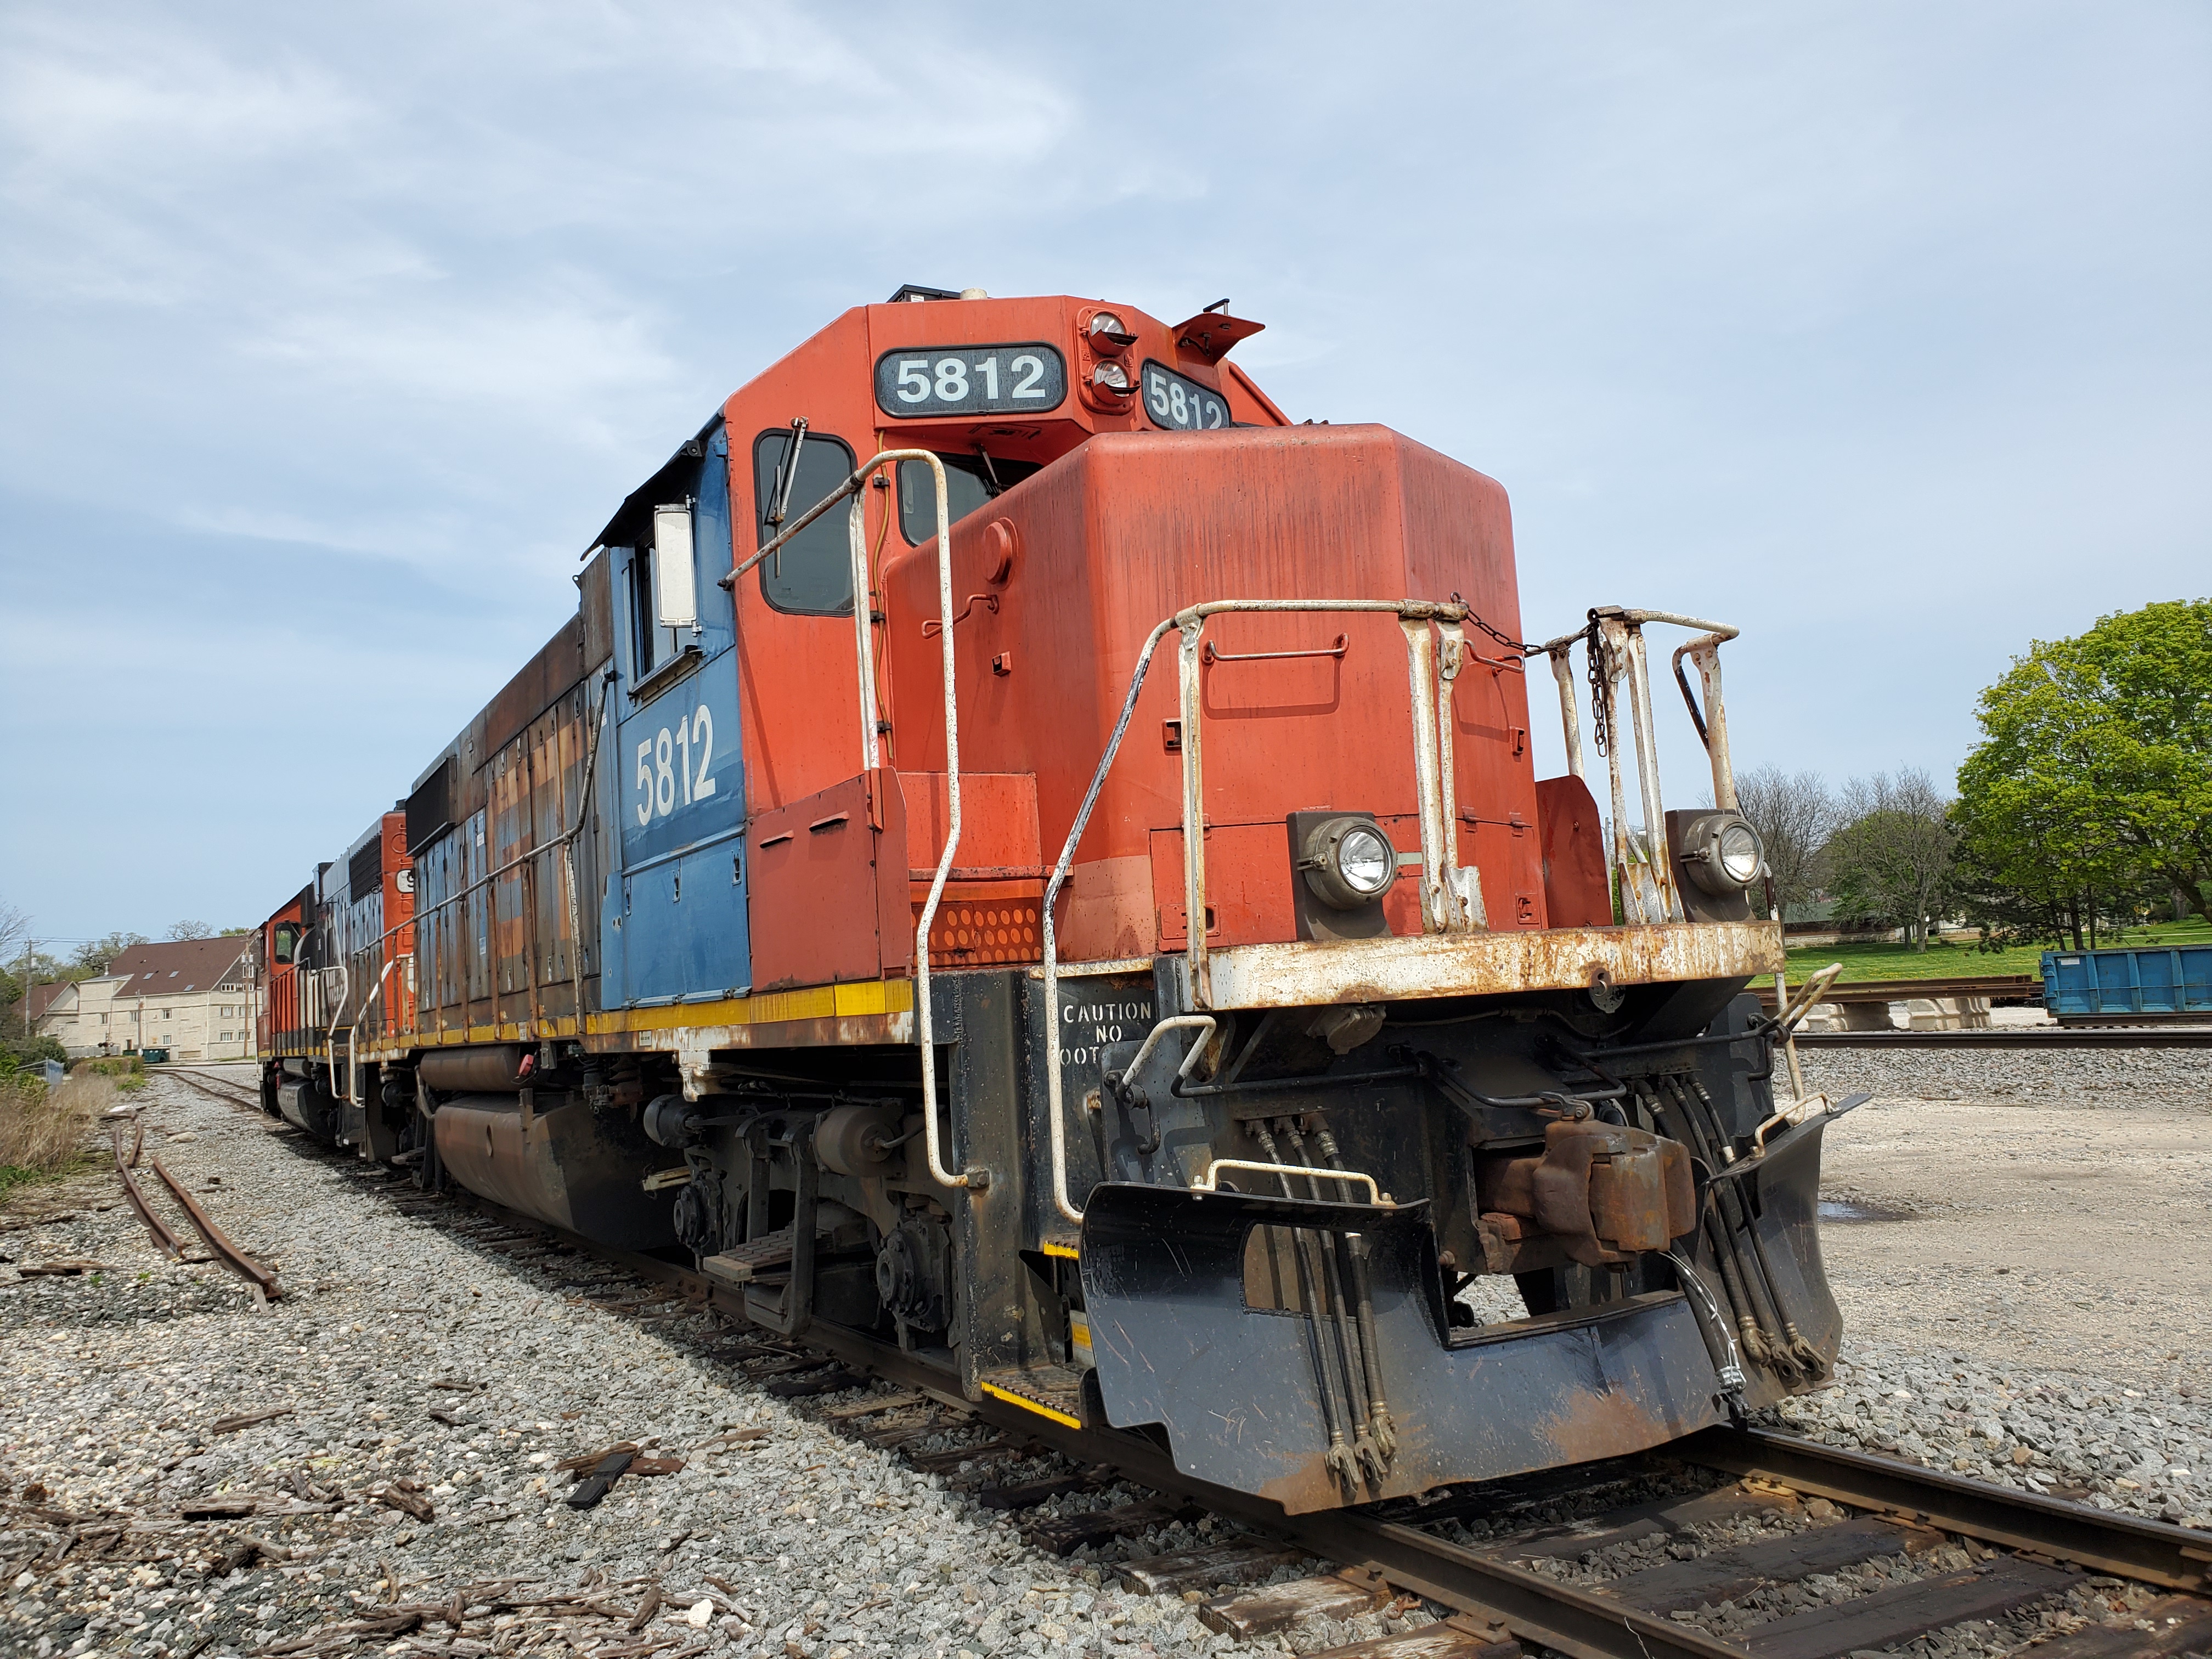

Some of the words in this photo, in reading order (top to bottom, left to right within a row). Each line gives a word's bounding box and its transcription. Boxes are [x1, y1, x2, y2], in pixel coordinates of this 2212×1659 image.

[896, 355, 1046, 403] 5812
[1151, 372, 1222, 430] 5812
[637, 704, 716, 826] 5812
[1063, 1002, 1151, 1023] CAUTION
[1096, 1025, 1122, 1043] NO
[1047, 1046, 1099, 1065] OOT
